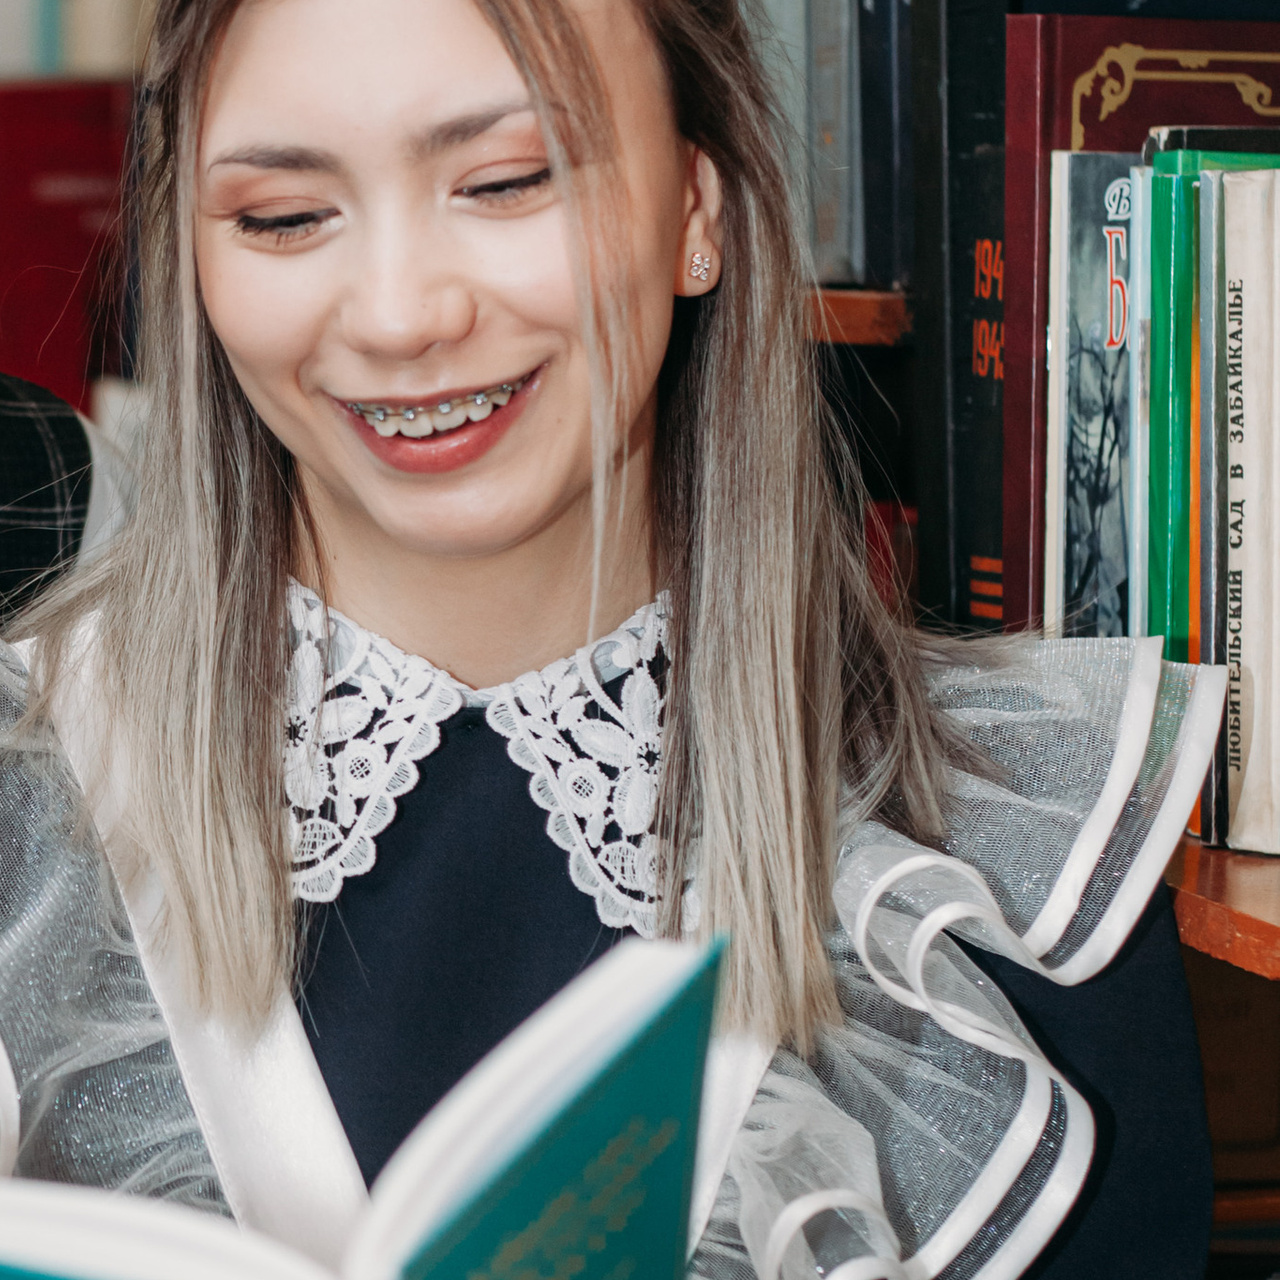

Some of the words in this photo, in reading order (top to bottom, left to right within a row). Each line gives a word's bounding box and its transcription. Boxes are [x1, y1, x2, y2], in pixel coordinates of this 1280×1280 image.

[1226, 279, 1244, 444] ЗАБАЙКАЛЬЕ
[1229, 464, 1244, 479] В
[1229, 500, 1245, 549] САД
[1229, 570, 1243, 772] ЛЮБИТЕЛЬСКИЙ
